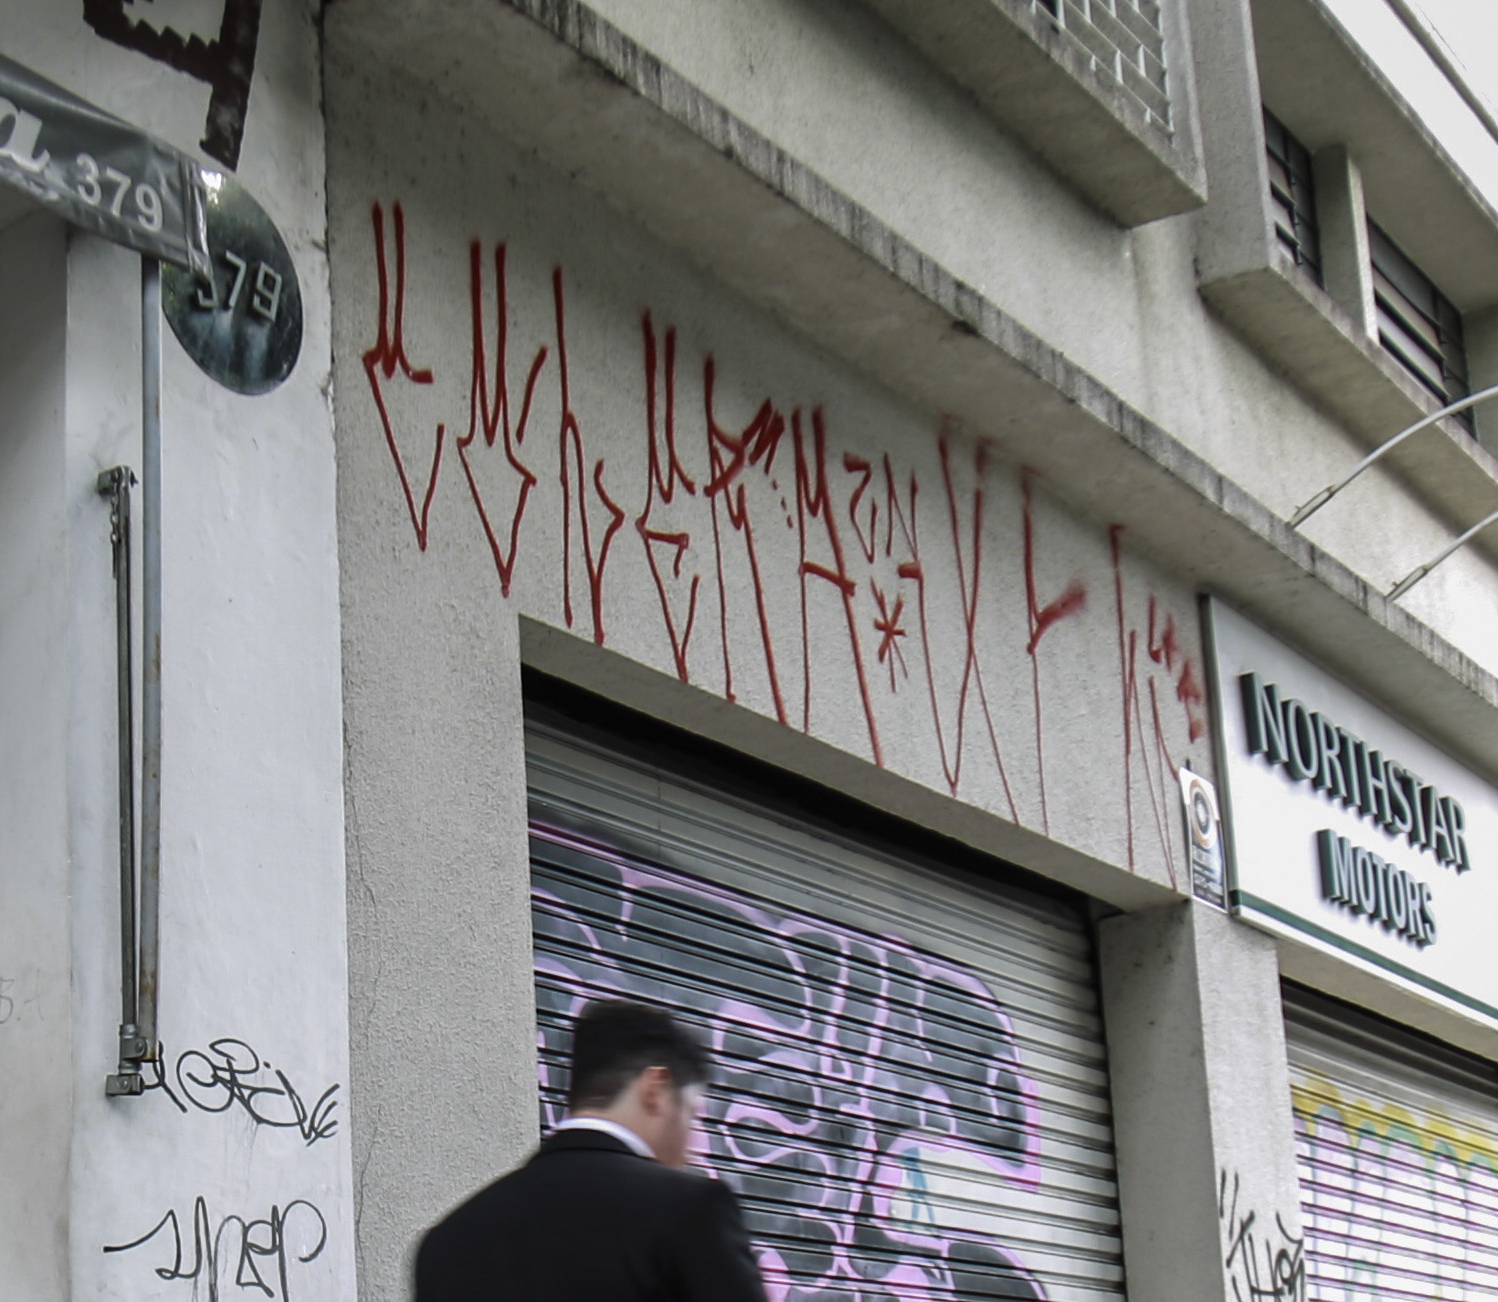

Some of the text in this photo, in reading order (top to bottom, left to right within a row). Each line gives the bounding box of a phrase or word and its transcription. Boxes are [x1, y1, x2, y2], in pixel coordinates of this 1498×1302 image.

[76, 152, 164, 232] 379
[1238, 671, 1471, 873] NORTHSTAR
[1316, 828, 1438, 949] MOTORS
